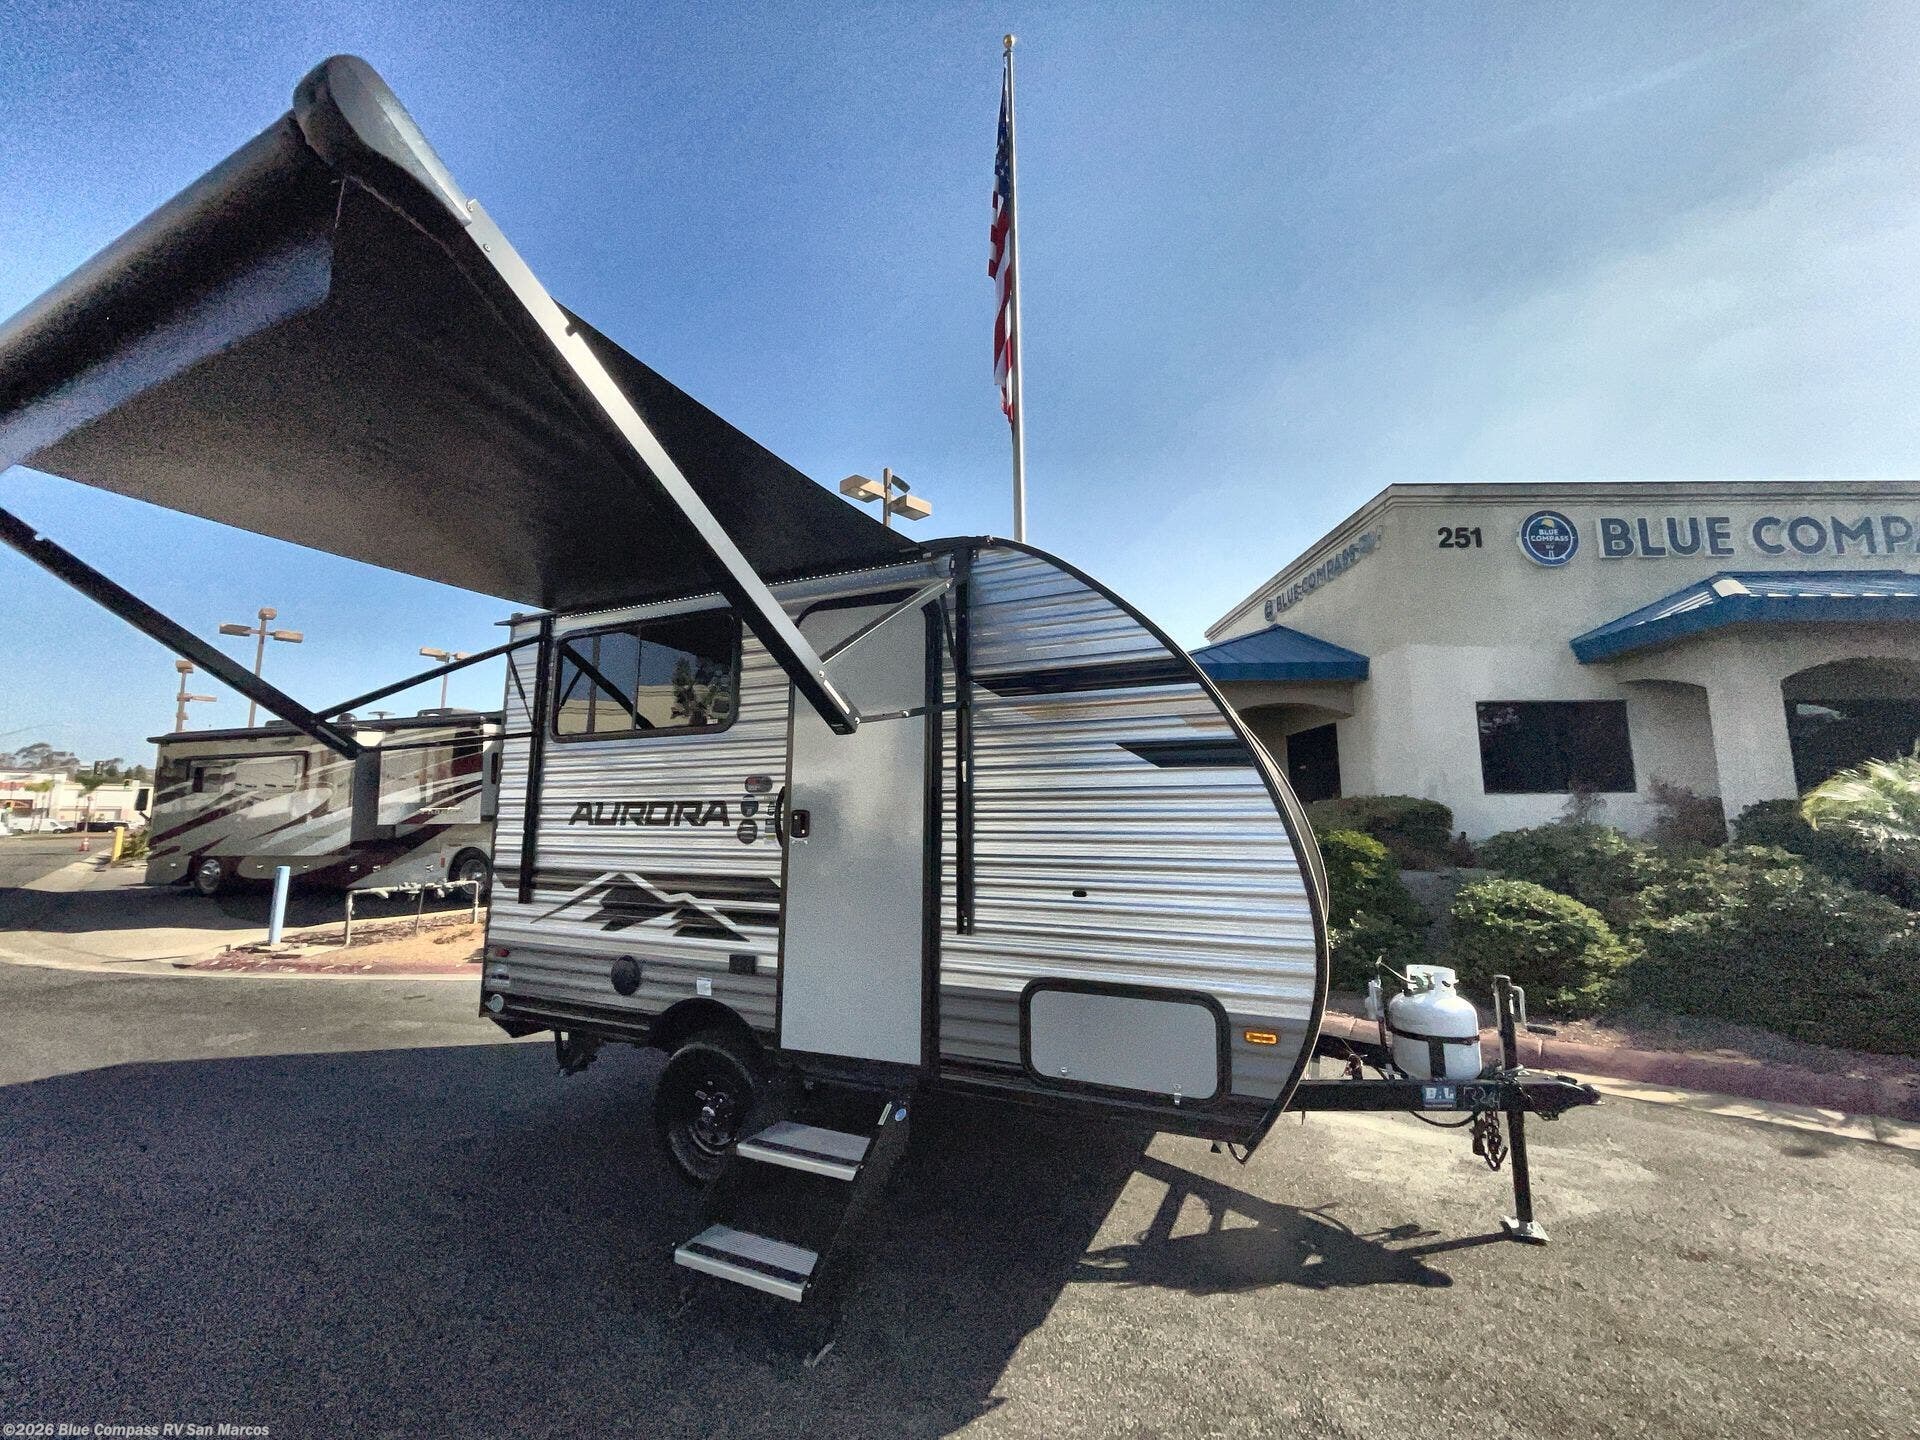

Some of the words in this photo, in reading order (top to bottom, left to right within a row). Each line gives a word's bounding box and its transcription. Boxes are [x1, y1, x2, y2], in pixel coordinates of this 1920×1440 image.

[1437, 527, 1483, 548] 251
[1538, 528, 1559, 536] BLUE
[1600, 516, 1735, 556] BLUE
[1752, 516, 1920, 554] COMP
[1276, 583, 1302, 612] BLUE
[568, 801, 730, 827] AURORA
